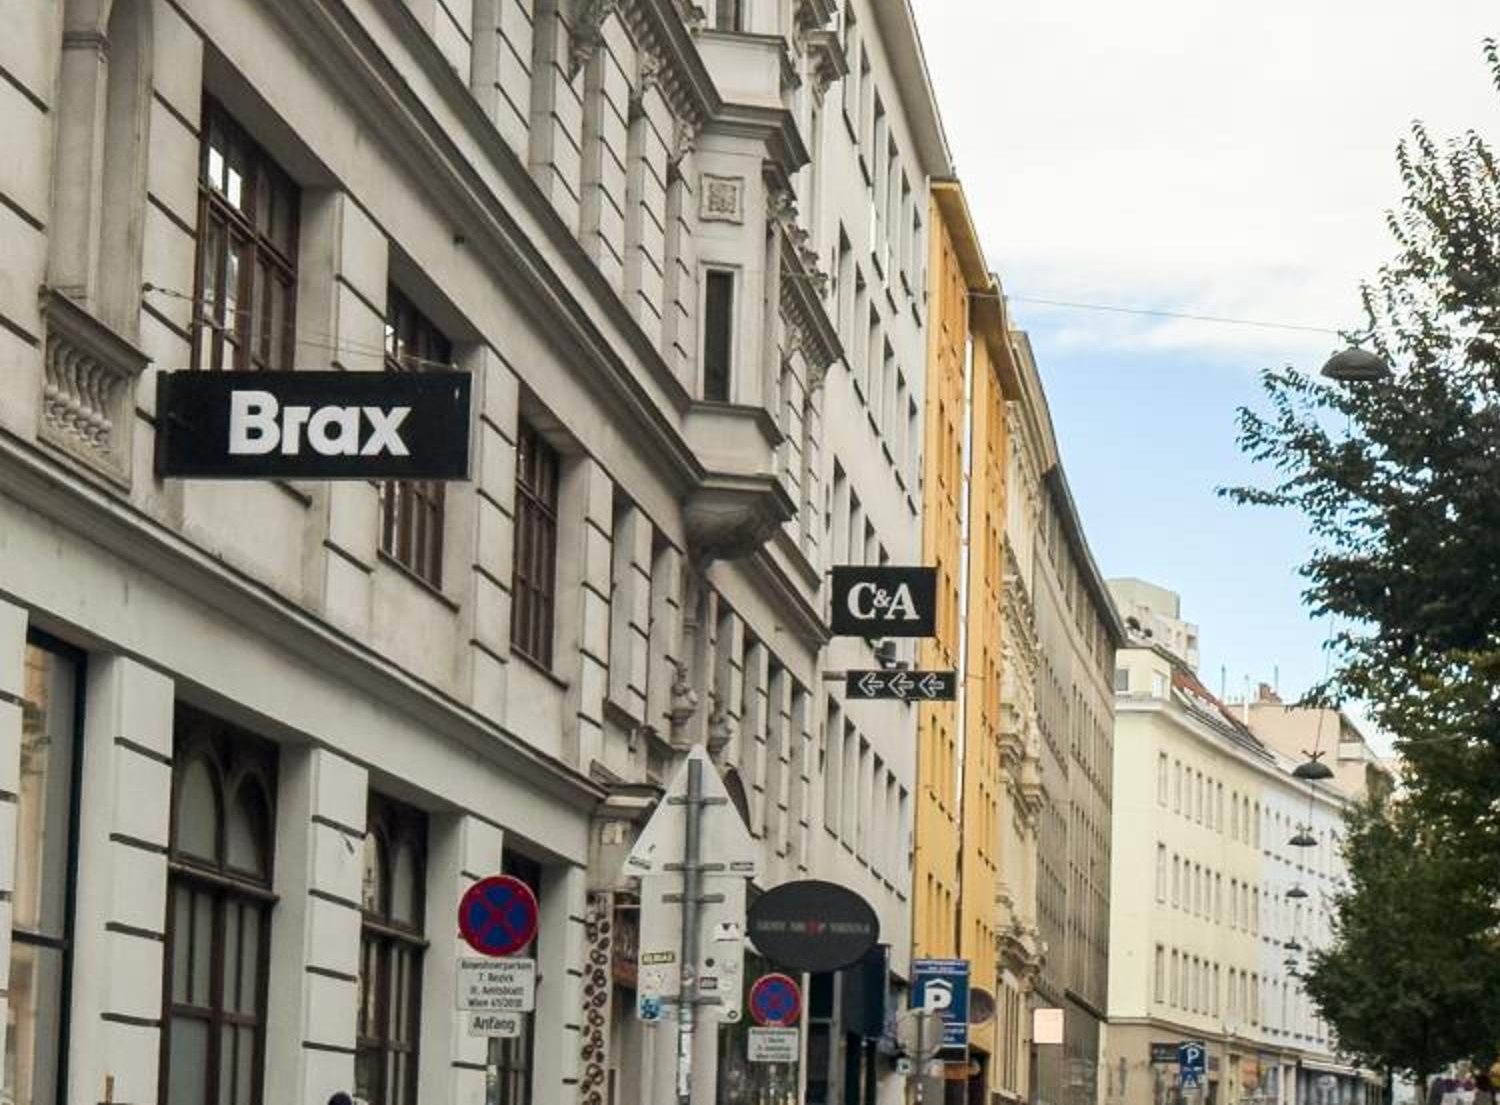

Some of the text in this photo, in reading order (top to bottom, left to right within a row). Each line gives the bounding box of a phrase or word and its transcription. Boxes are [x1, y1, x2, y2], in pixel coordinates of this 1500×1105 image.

[228, 390, 412, 456] Brax
[847, 582, 920, 620] C&A
[923, 987, 952, 1014] P
[473, 1016, 516, 1034] Anfang
[1186, 1048, 1199, 1064] P
